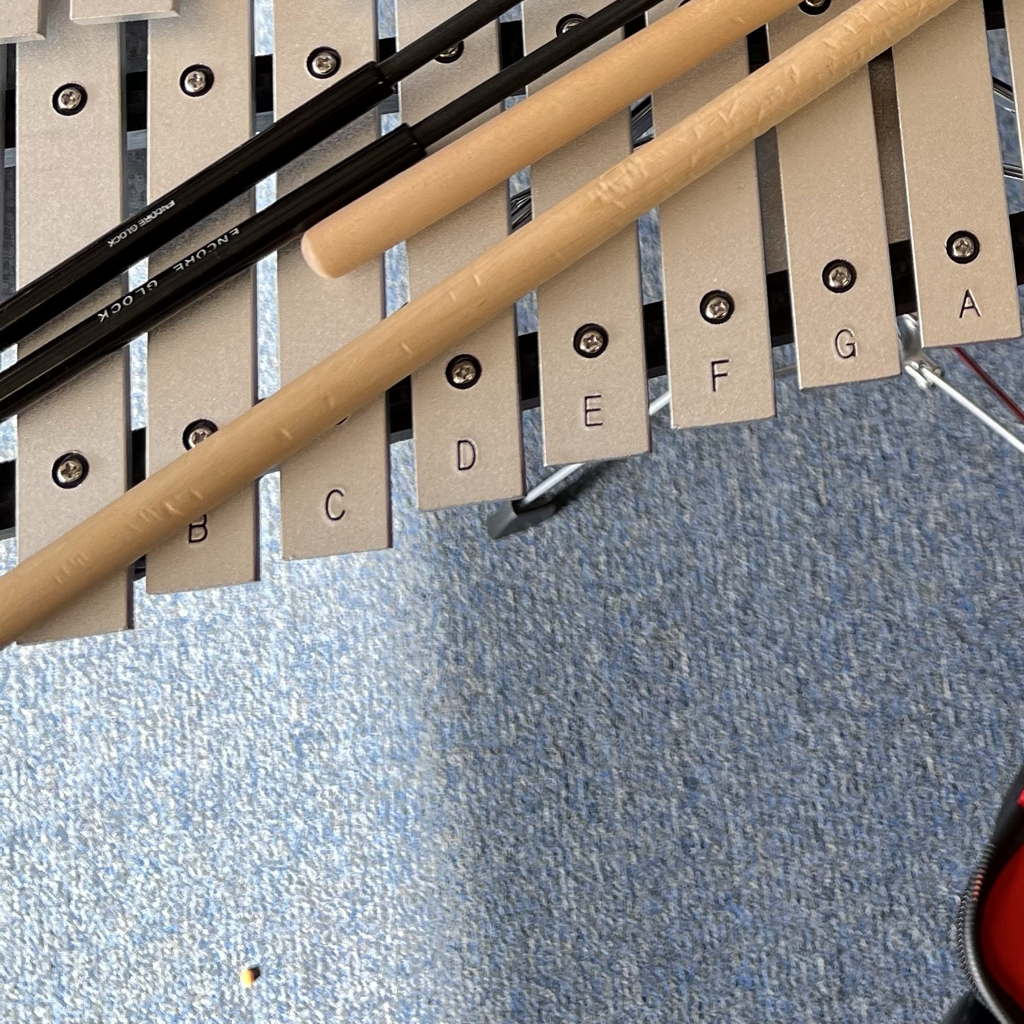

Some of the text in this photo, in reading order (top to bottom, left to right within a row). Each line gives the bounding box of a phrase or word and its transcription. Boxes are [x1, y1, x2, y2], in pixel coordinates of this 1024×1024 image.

[107, 199, 176, 247] ENCORE GLOCK
[97, 227, 240, 322] ENCORE GLOCK
[958, 289, 983, 319] A
[834, 329, 857, 359] G
[710, 359, 730, 392] F
[584, 395, 603, 426] E
[457, 440, 477, 470] D
[325, 489, 346, 521] C
[188, 514, 209, 543] B
